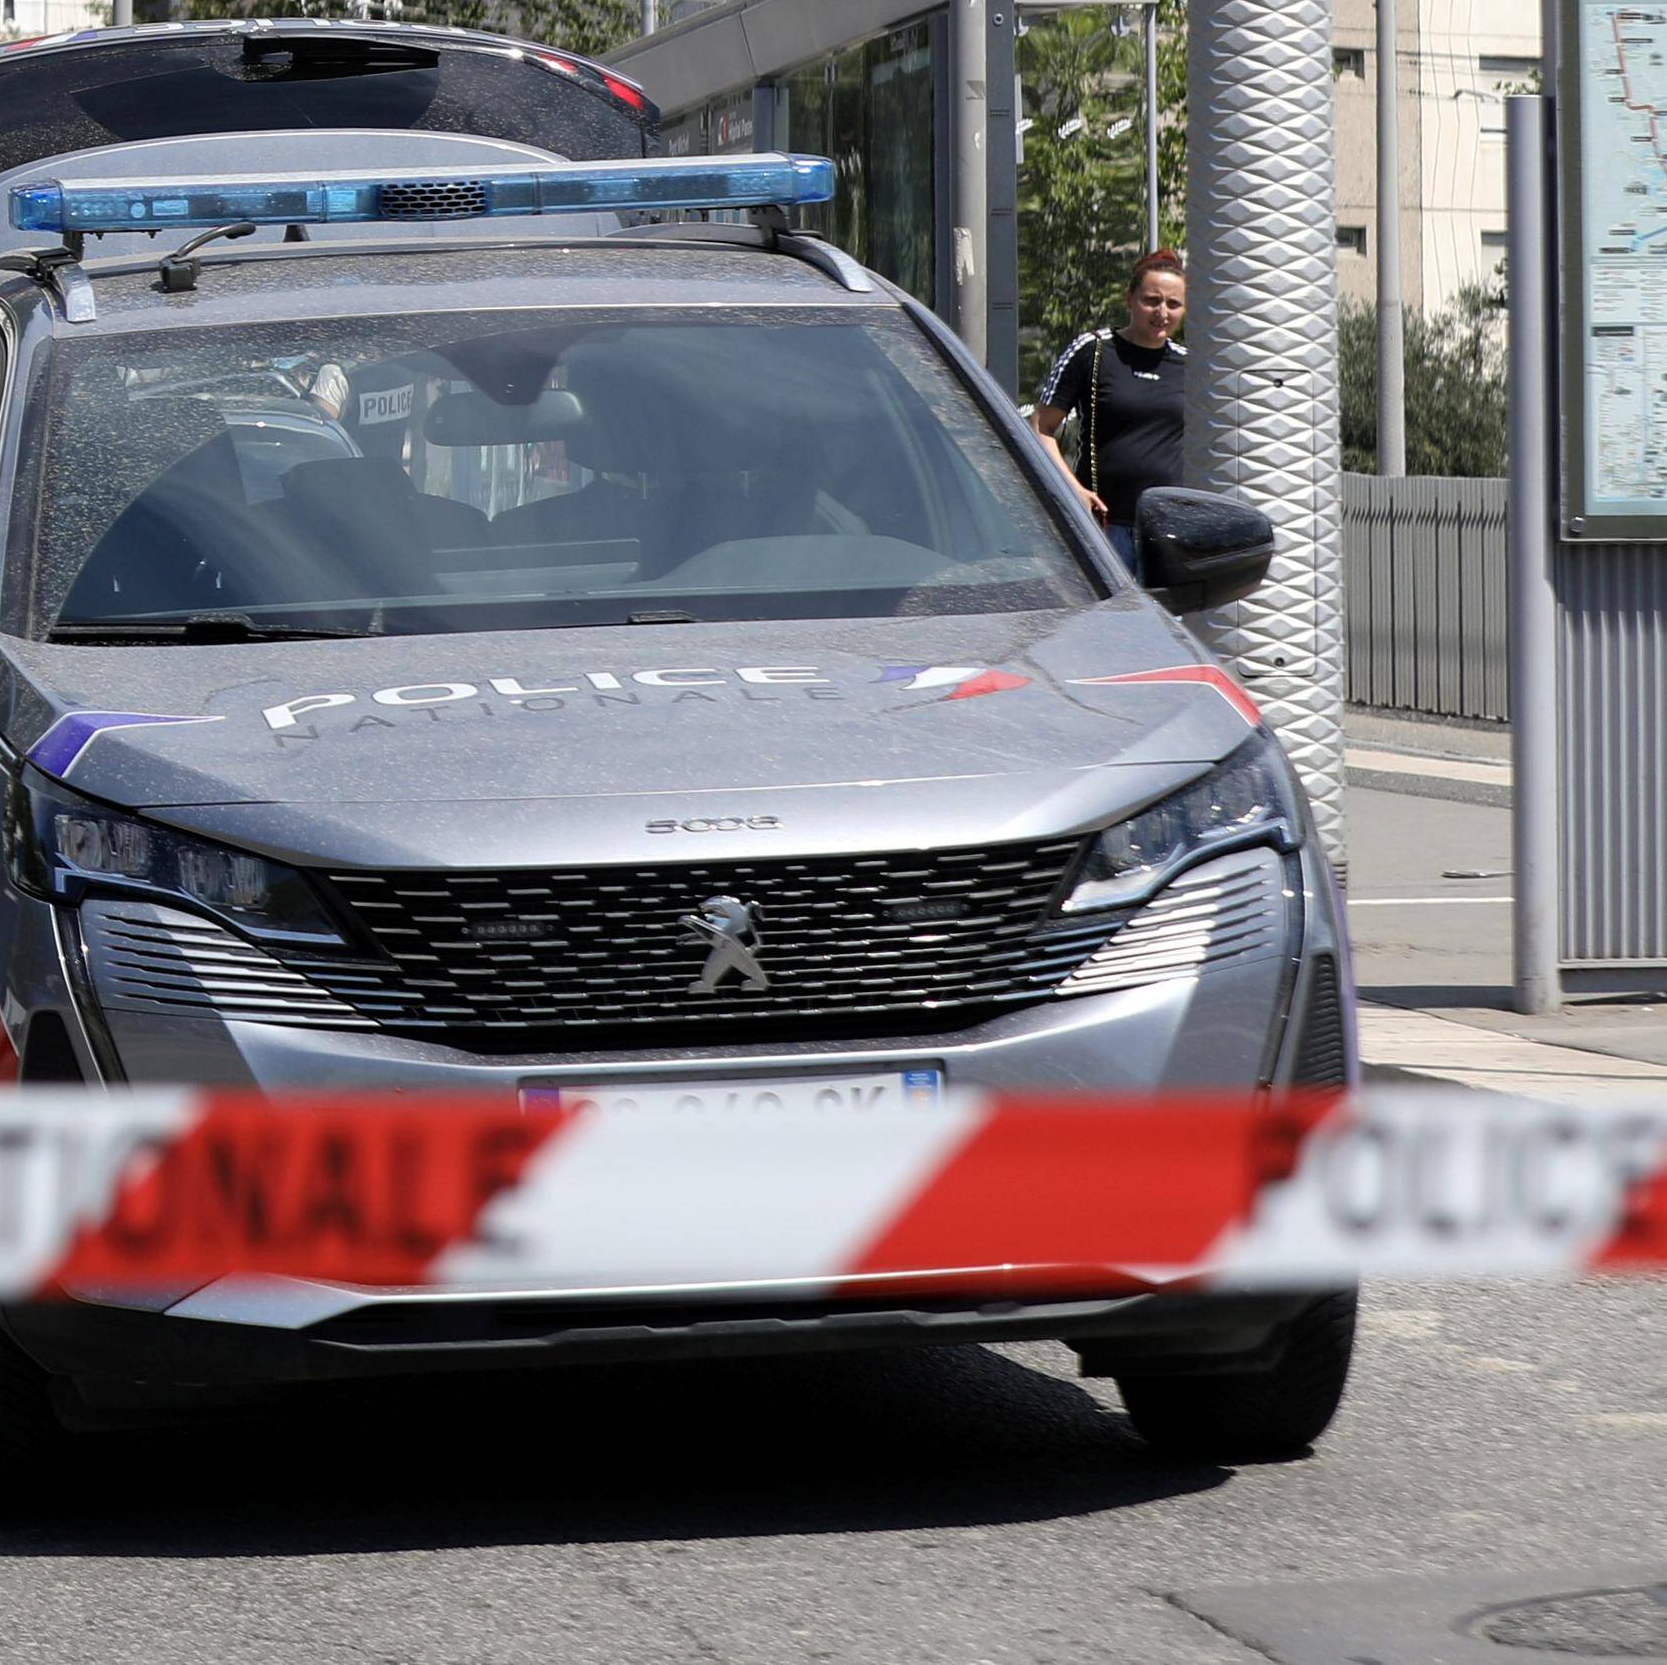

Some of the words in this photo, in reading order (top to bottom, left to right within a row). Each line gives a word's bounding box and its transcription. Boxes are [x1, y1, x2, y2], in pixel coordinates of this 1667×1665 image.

[363, 391, 412, 418] POLICE
[261, 665, 831, 729] POLICE
[273, 686, 847, 747] NATIONALE
[1251, 1106, 1667, 1238] POLICE
